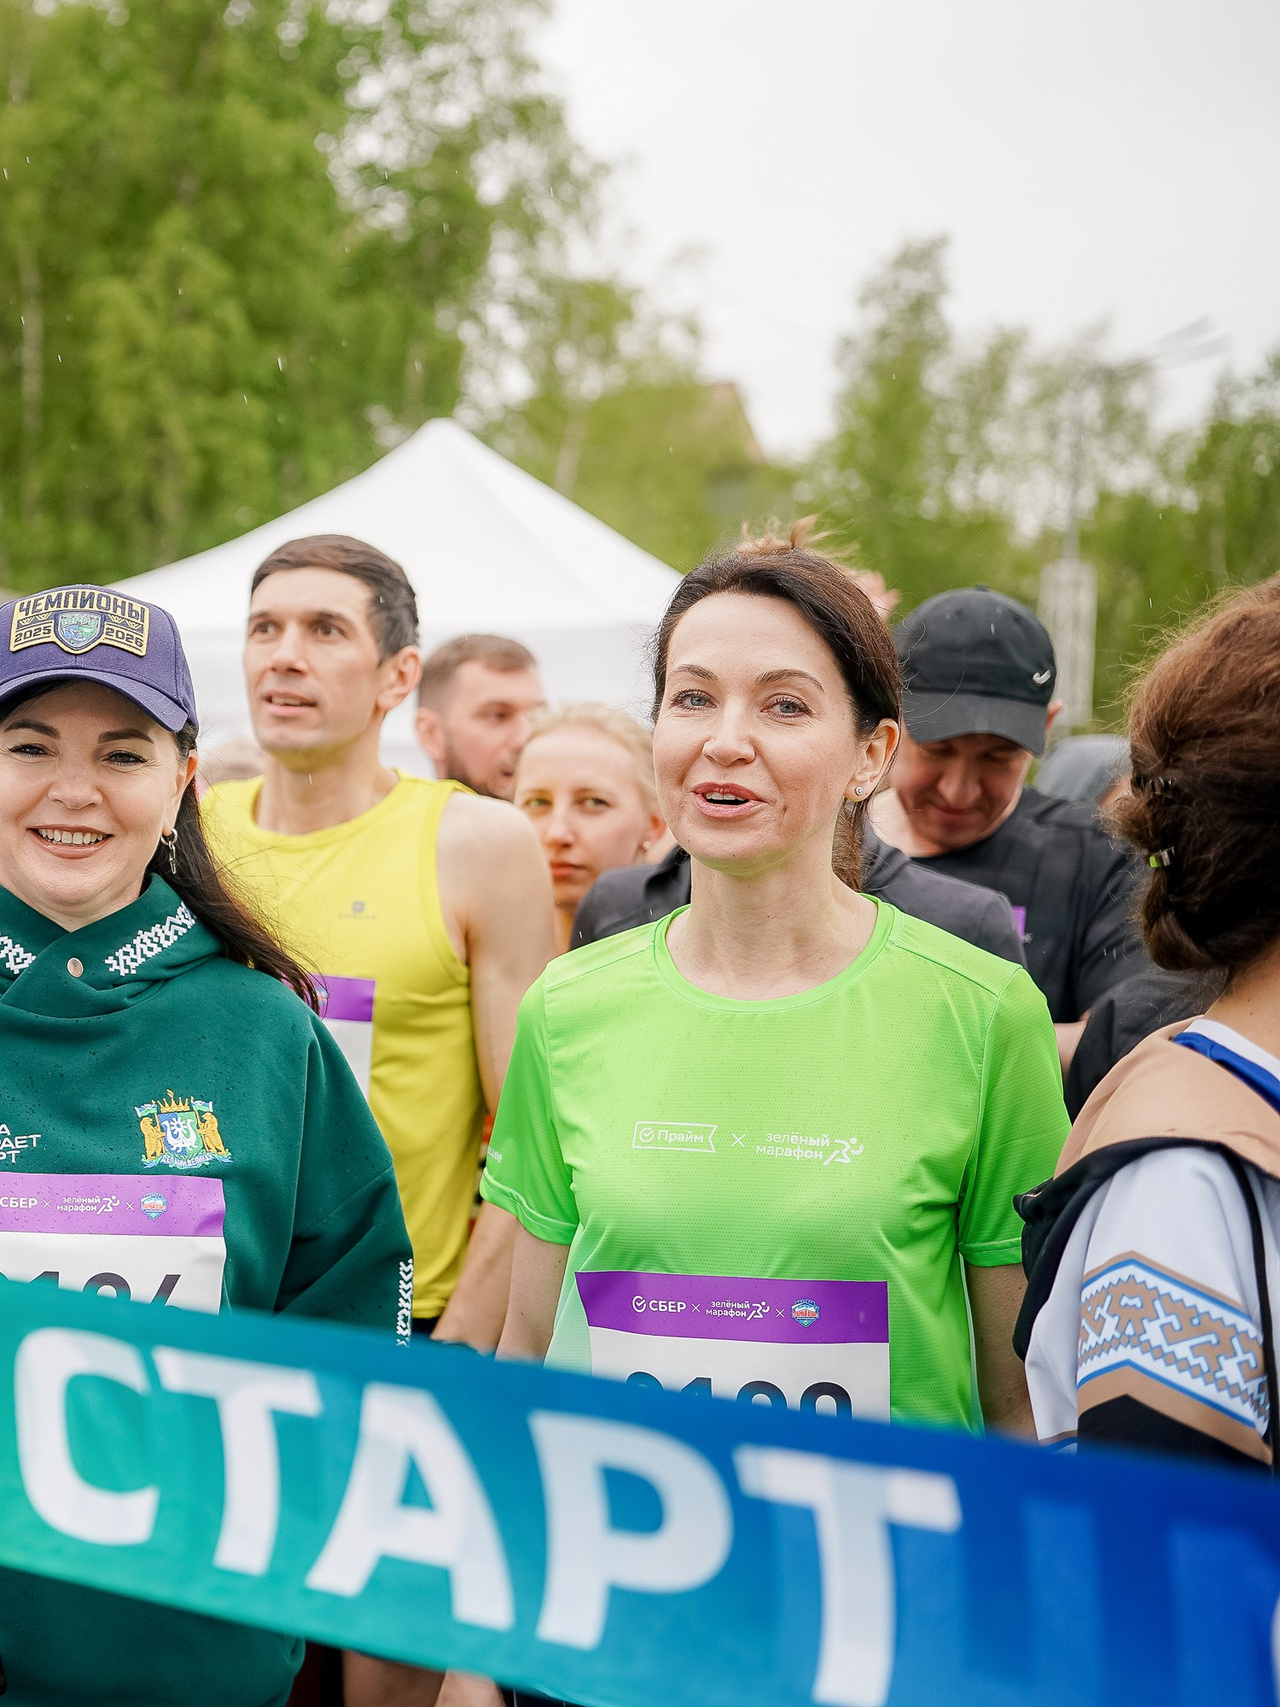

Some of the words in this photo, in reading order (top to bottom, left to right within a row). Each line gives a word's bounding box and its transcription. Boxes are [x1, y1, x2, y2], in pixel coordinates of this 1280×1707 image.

[19, 591, 145, 623] ЧЕМПИОНЫ
[15, 626, 51, 642] 2025
[105, 627, 144, 647] 2026
[657, 1130, 704, 1143] Прайм
[765, 1131, 830, 1147] зелёный
[755, 1144, 824, 1160] марафон
[0, 1196, 39, 1208] СБЕР
[61, 1196, 100, 1204] зелёный
[56, 1203, 97, 1213] марафон
[648, 1300, 687, 1313] СБЕР
[710, 1300, 750, 1310] зелёный
[705, 1308, 747, 1318] марафон
[13, 1328, 962, 1707] СТАРТ
